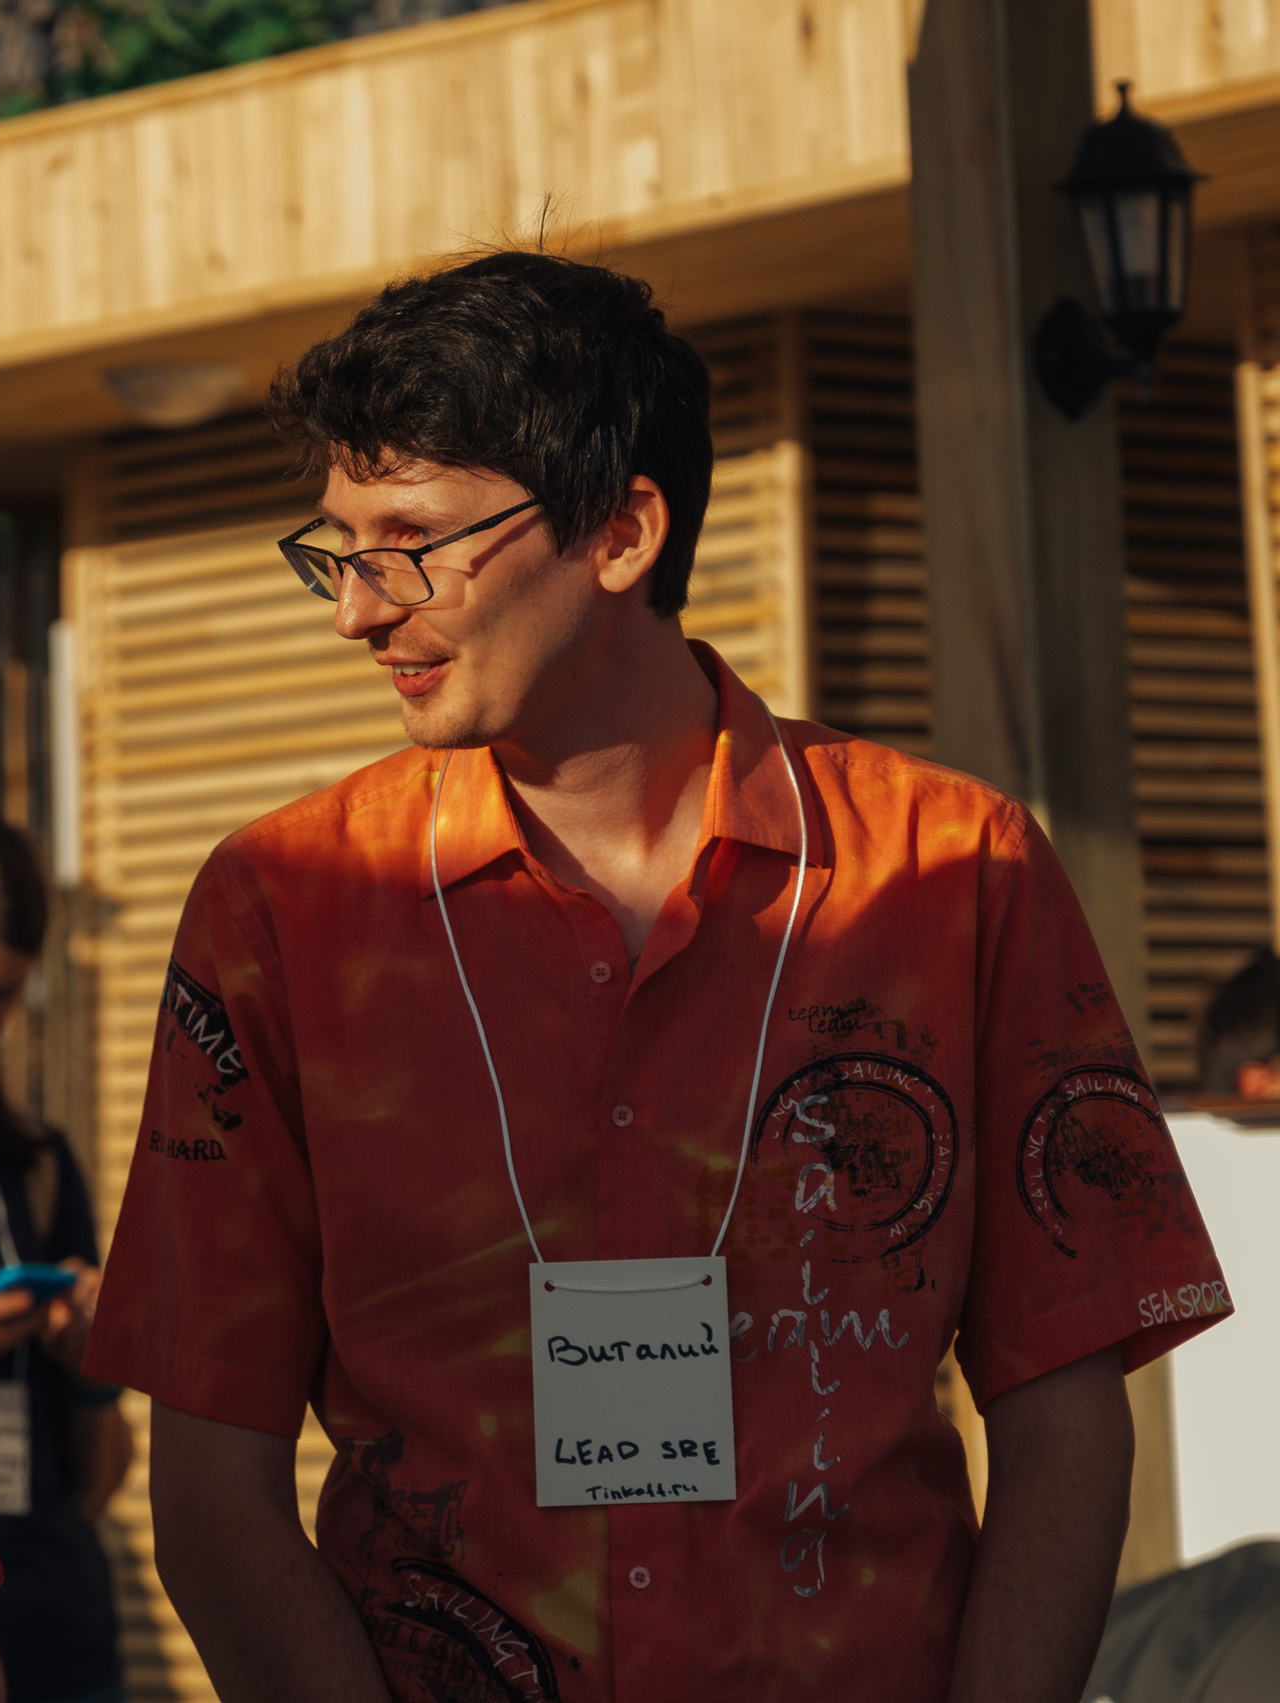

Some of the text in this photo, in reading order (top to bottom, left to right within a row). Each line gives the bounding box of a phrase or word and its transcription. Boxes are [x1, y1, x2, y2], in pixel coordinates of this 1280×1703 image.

[1065, 1078, 1140, 1102] SAILING
[1138, 1288, 1180, 1329] SEA
[548, 1322, 719, 1366] Виталий
[555, 1438, 721, 1465] LEAD SRE
[404, 1573, 530, 1668] SAILING
